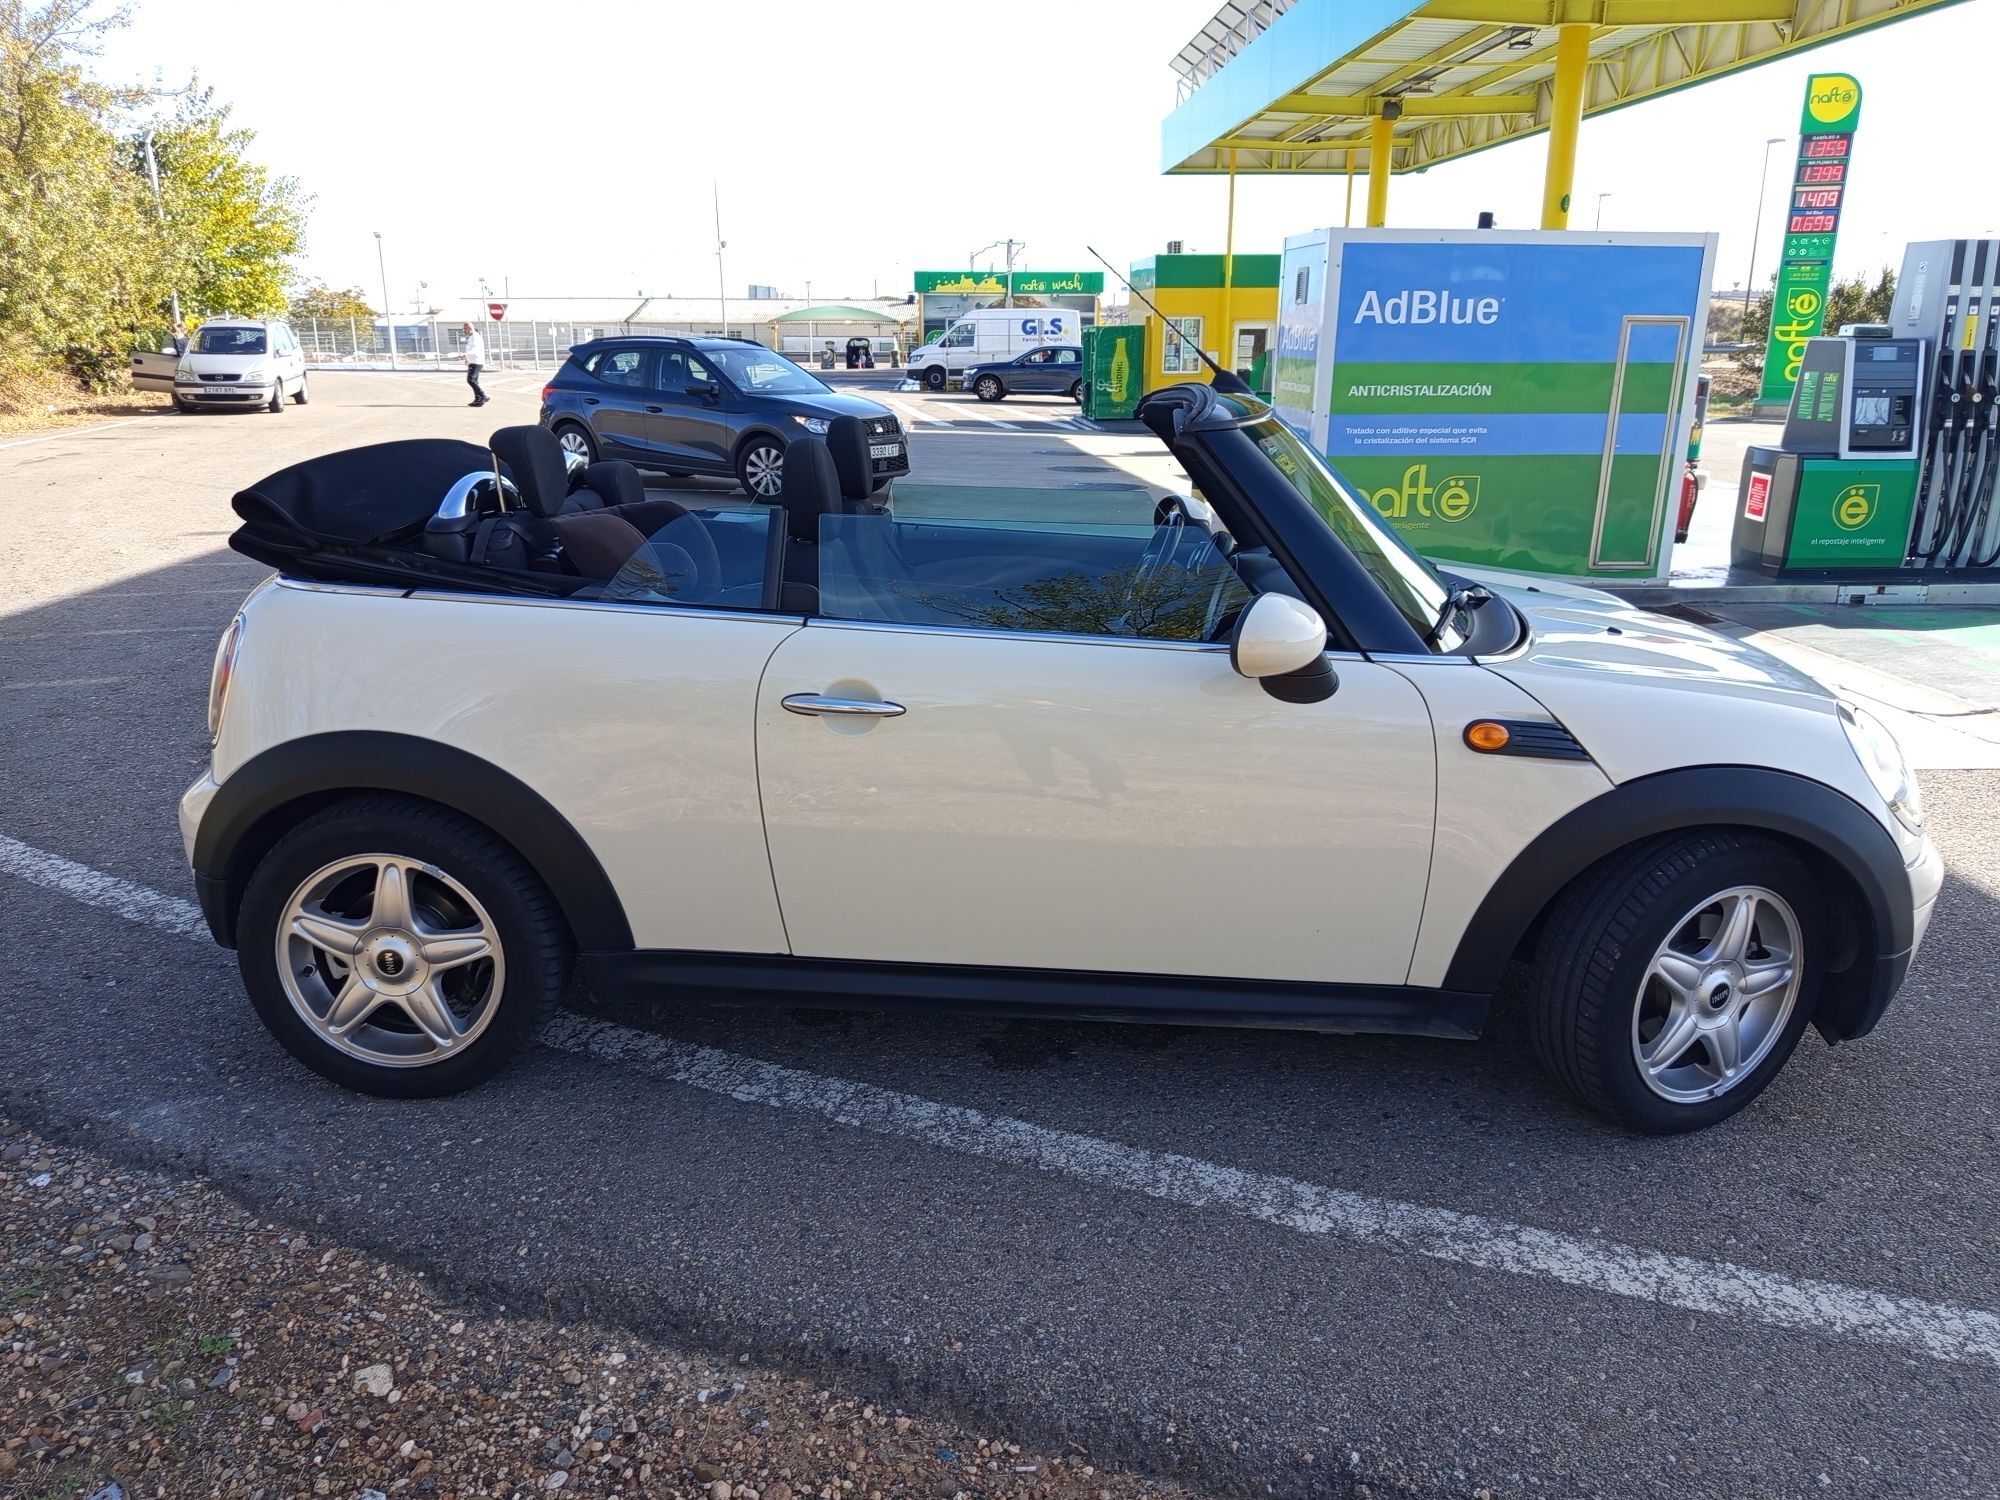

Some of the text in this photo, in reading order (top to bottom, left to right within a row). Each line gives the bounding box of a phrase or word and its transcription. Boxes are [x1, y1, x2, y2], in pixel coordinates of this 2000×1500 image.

[1804, 166, 1843, 182] 1.399
[1800, 191, 1839, 207] 1.409
[1790, 215, 1835, 232] 0.699
[1052, 274, 1083, 291] wash
[1354, 290, 1499, 325] AdBlue
[1281, 324, 1316, 352] AdBlue
[1348, 383, 1492, 397] ANTICRISTALIZACIÓN
[1345, 427, 1375, 435] Tratado
[1419, 427, 1451, 436] especial
[1452, 428, 1467, 436] que
[1363, 437, 1414, 445] cristalización
[1460, 436, 1477, 444] SCR
[1819, 538, 1849, 546] repostaje
[1850, 538, 1886, 546] inteligente
[384, 952, 395, 973] MINI
[1711, 988, 1728, 1004] MINI
